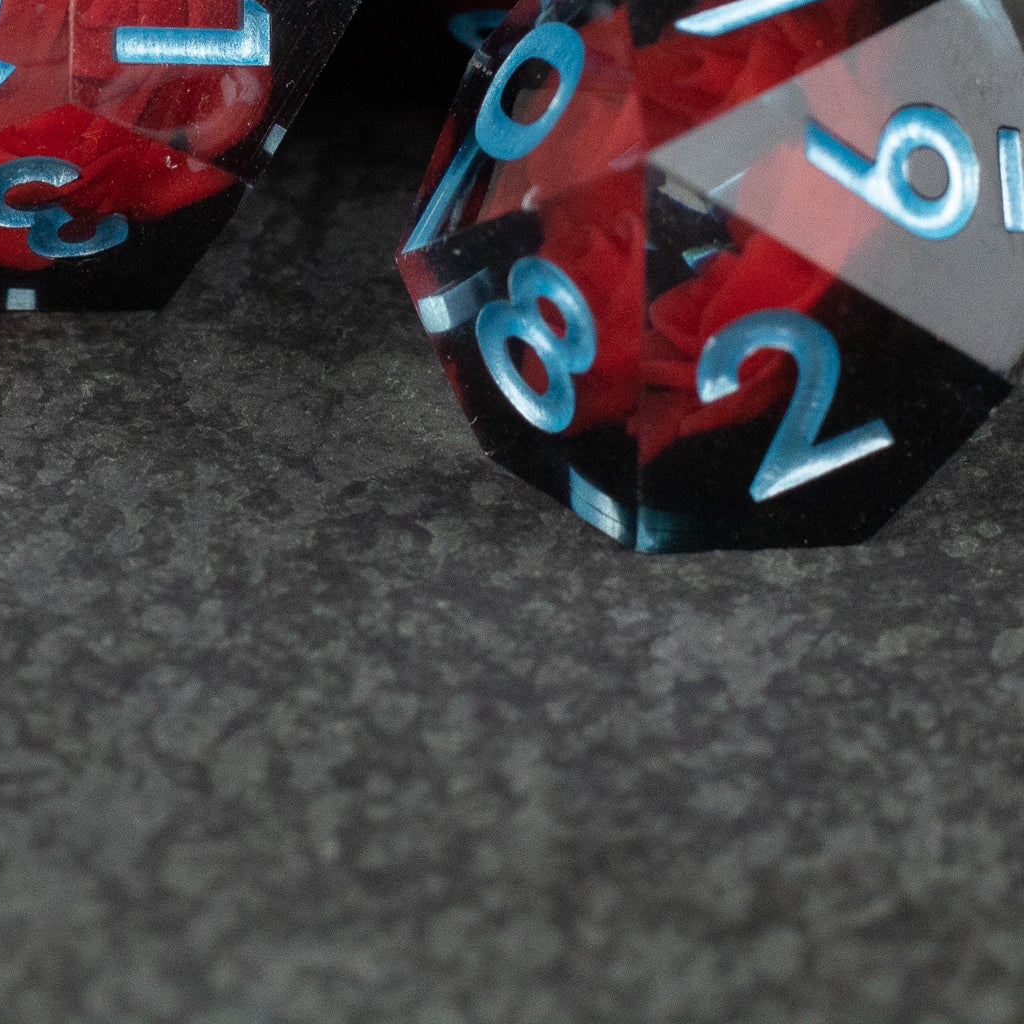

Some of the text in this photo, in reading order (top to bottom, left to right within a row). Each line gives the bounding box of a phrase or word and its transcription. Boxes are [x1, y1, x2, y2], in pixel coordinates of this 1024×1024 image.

[475, 21, 586, 162] 0
[476, 256, 597, 435] 8
[696, 307, 895, 504] 2
